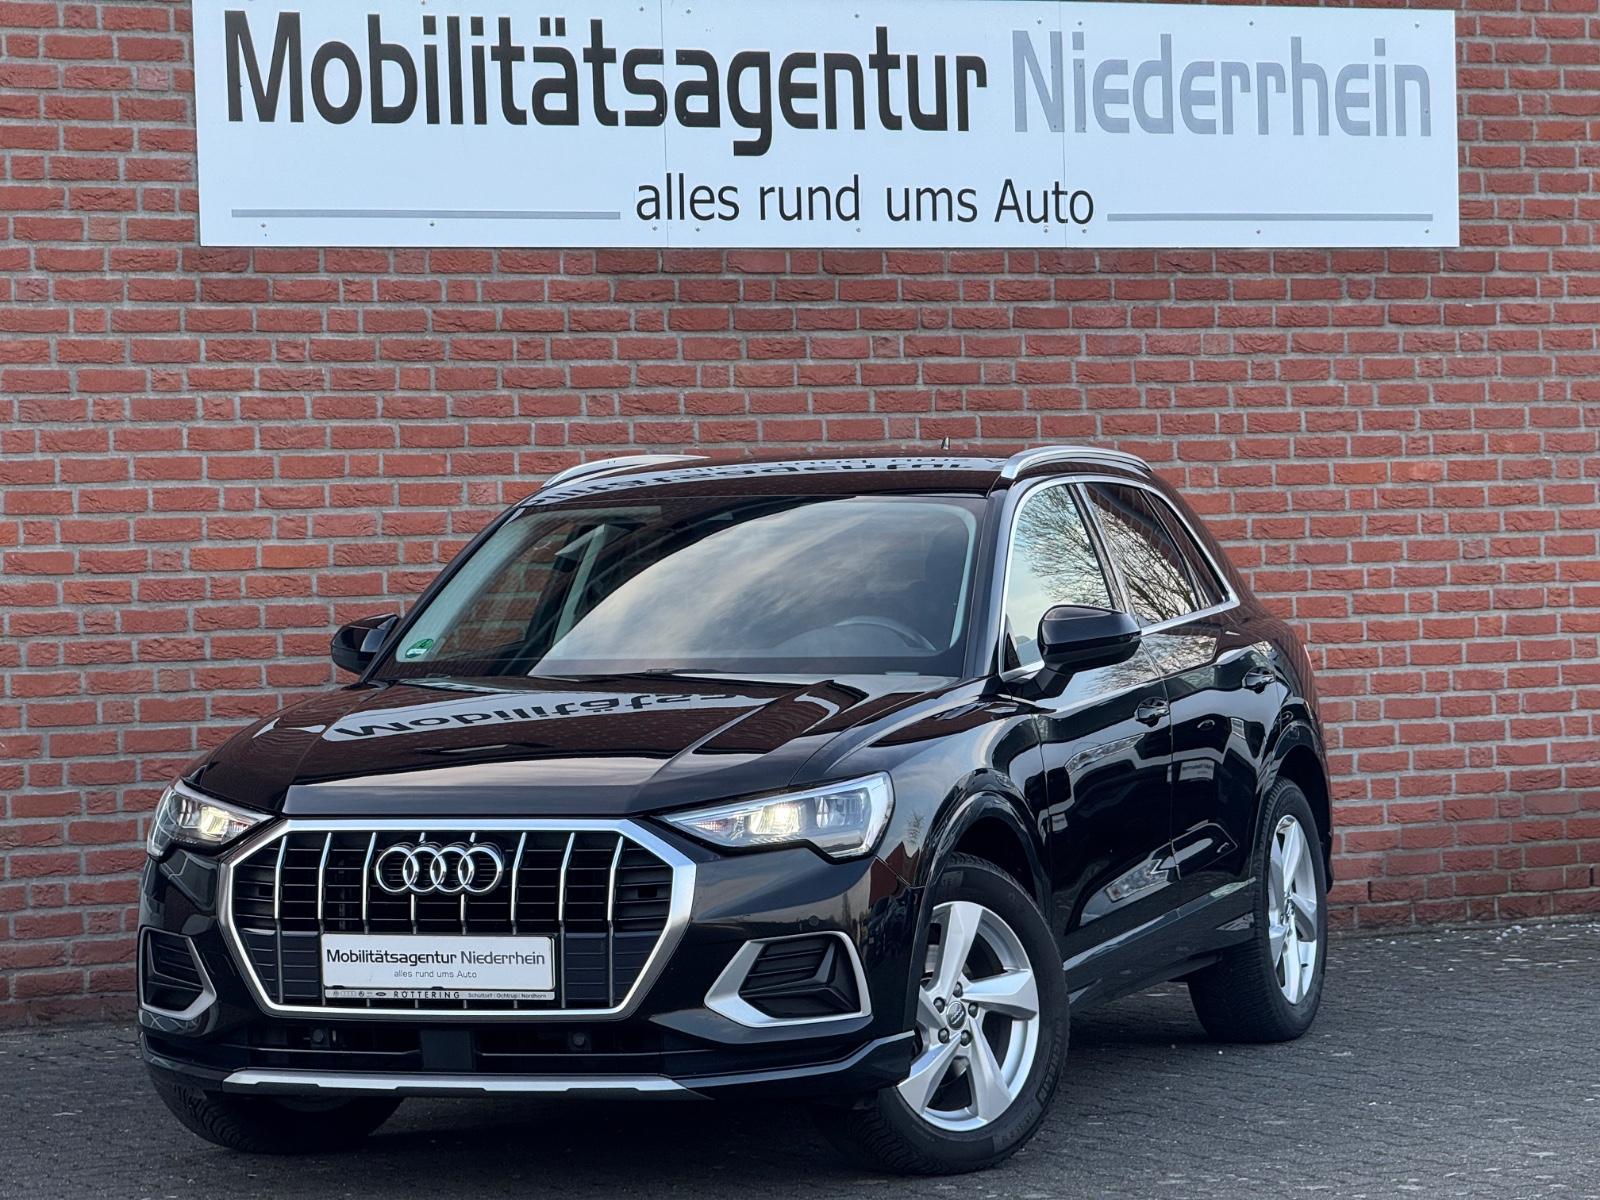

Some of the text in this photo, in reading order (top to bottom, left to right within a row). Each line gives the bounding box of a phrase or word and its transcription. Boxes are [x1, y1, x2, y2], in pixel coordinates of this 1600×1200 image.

[224, 10, 1432, 157] Mobilitätsagentur Niederrhein
[635, 172, 1094, 225] alles rund ums Auto
[326, 948, 546, 967] Mobilitätsagentur Niederrhein
[393, 969, 478, 979] alles rund ums Auto
[393, 990, 460, 999] RÖTTERING
